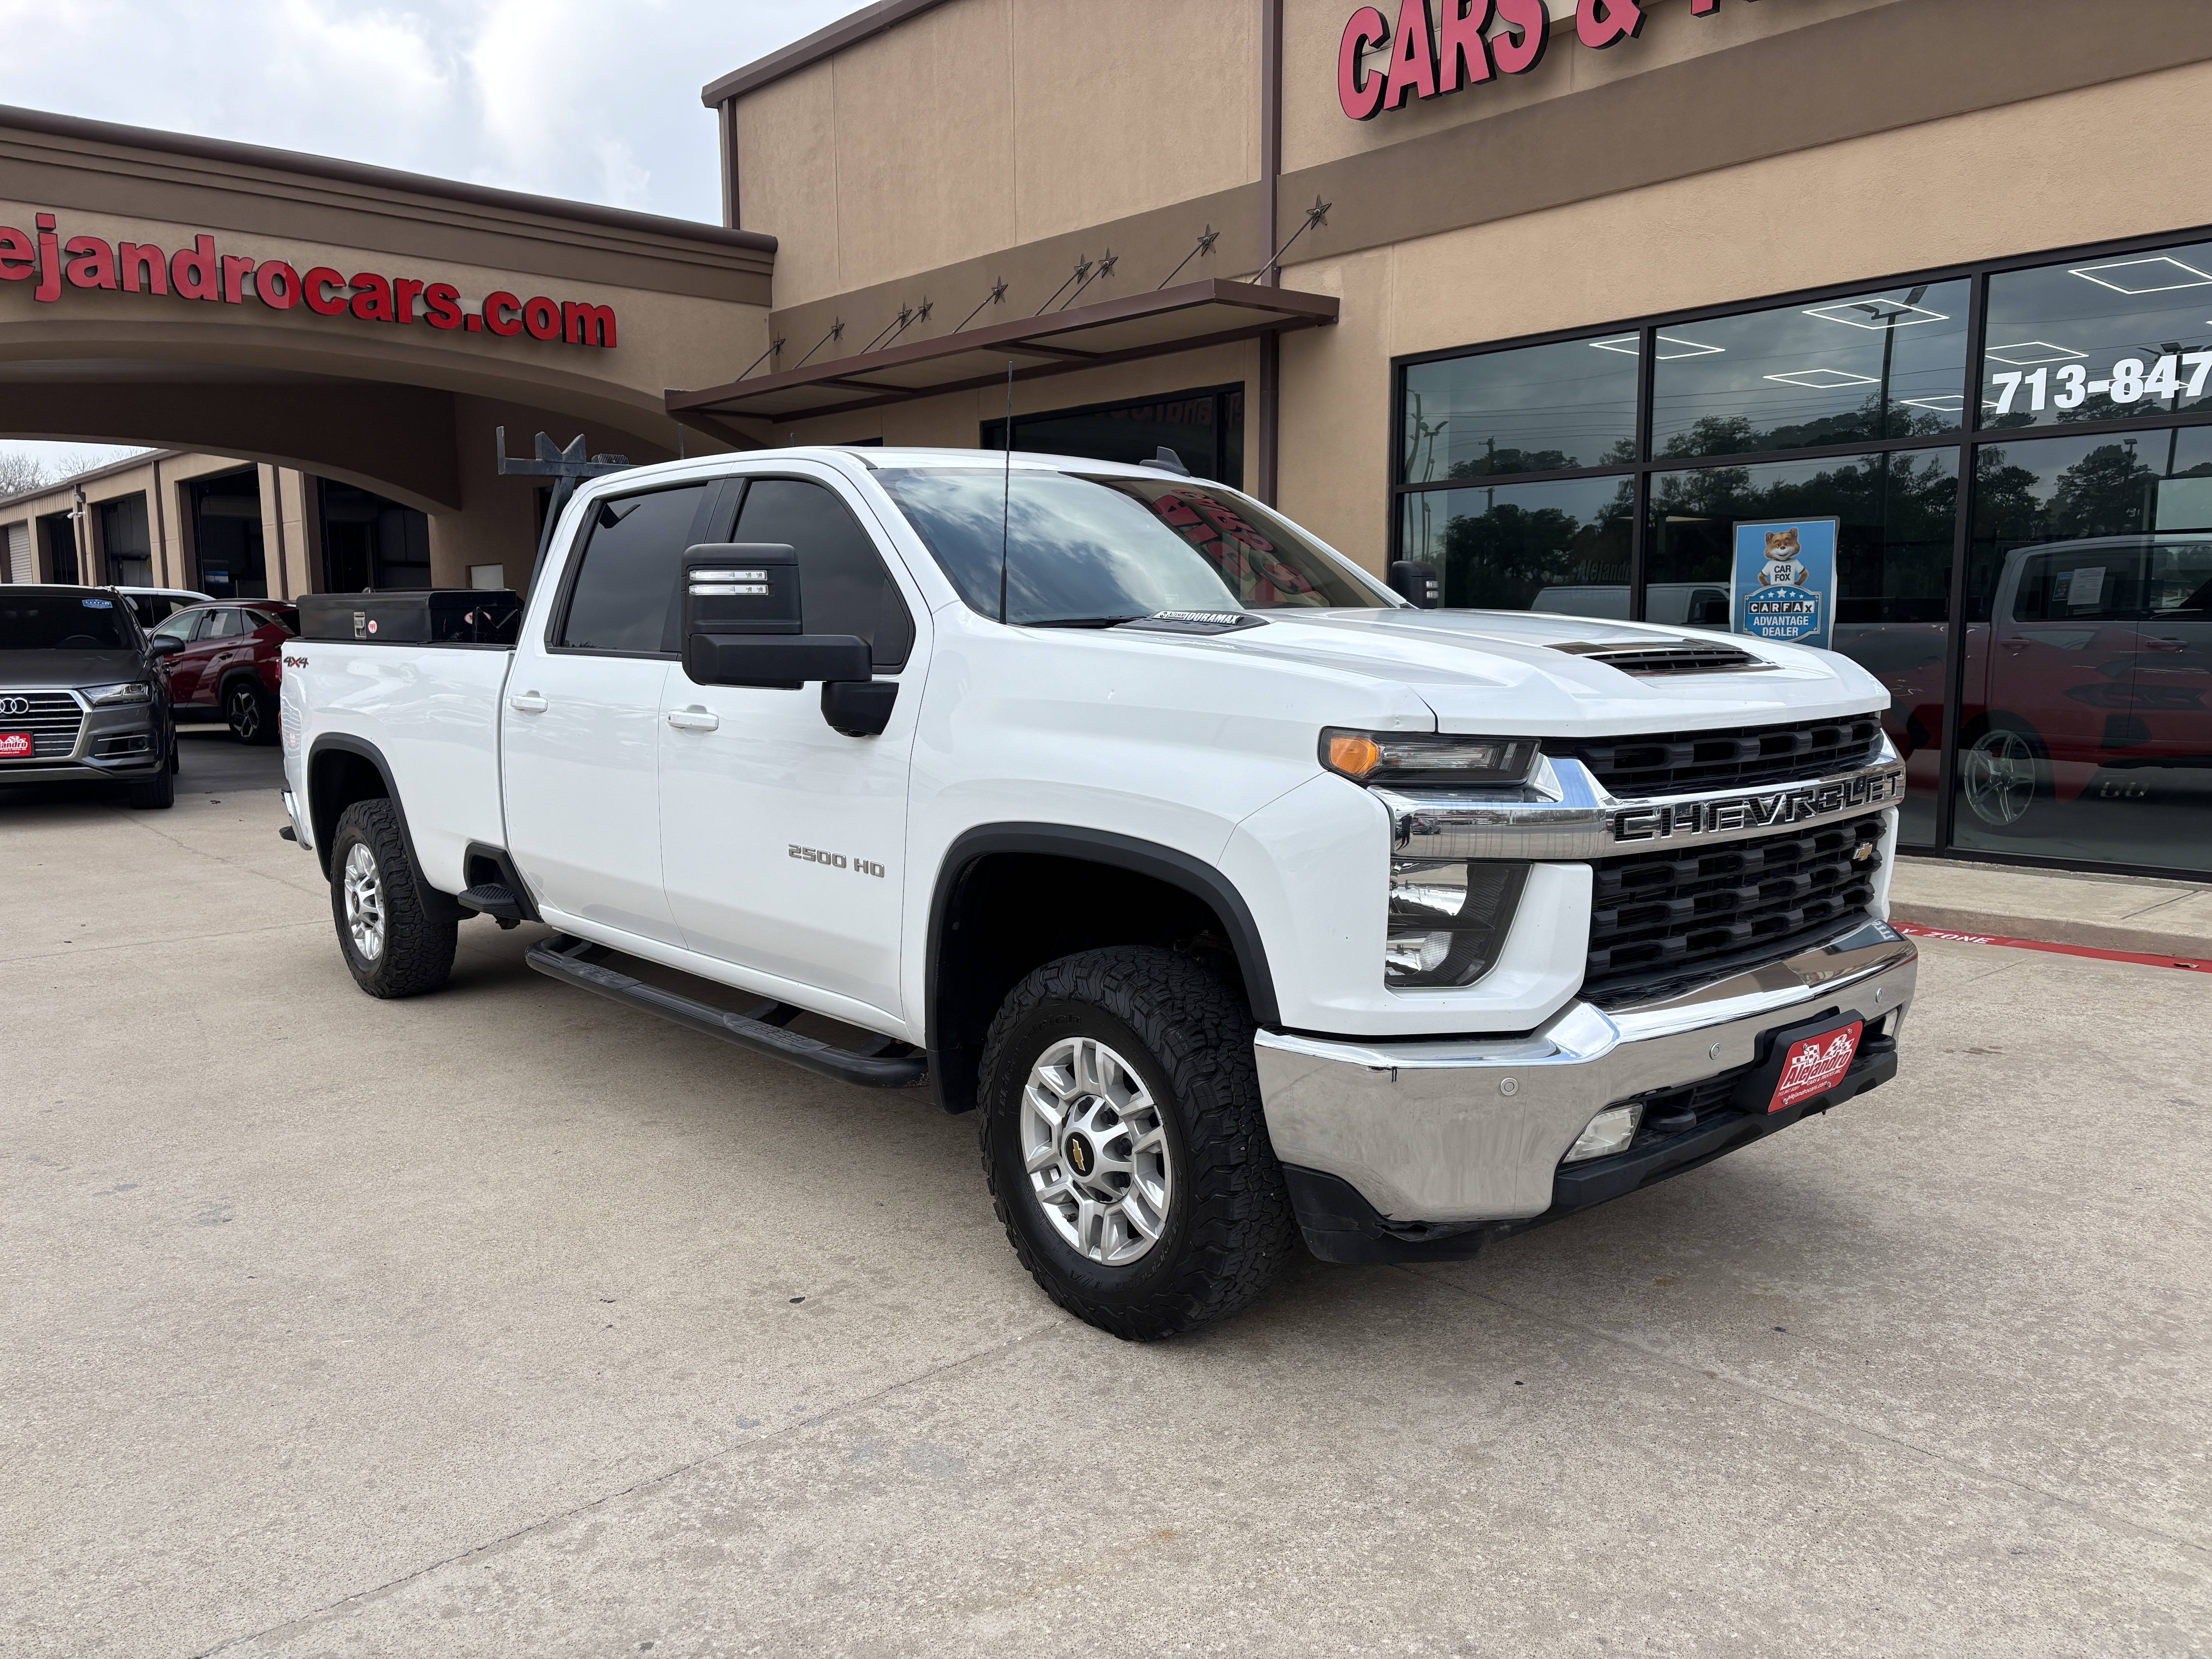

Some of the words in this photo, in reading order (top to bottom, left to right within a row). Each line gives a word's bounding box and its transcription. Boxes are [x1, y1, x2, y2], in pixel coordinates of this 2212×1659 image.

[1338, 0, 1549, 121] CARS
[1992, 351, 2212, 414] 713-847
[1774, 565, 1791, 573] CAR
[1750, 601, 1814, 613] CARFAX
[1185, 613, 1240, 624] DURAMAX
[1753, 616, 1809, 625] ADVANTAGE
[1762, 627, 1798, 636] DEALER
[1614, 770, 1903, 844] CHEVROLET
[788, 843, 847, 869] 2500
[854, 857, 884, 878] HD
[1923, 932, 1995, 944] ZONE
[1781, 1049, 1853, 1090] Alejandro
